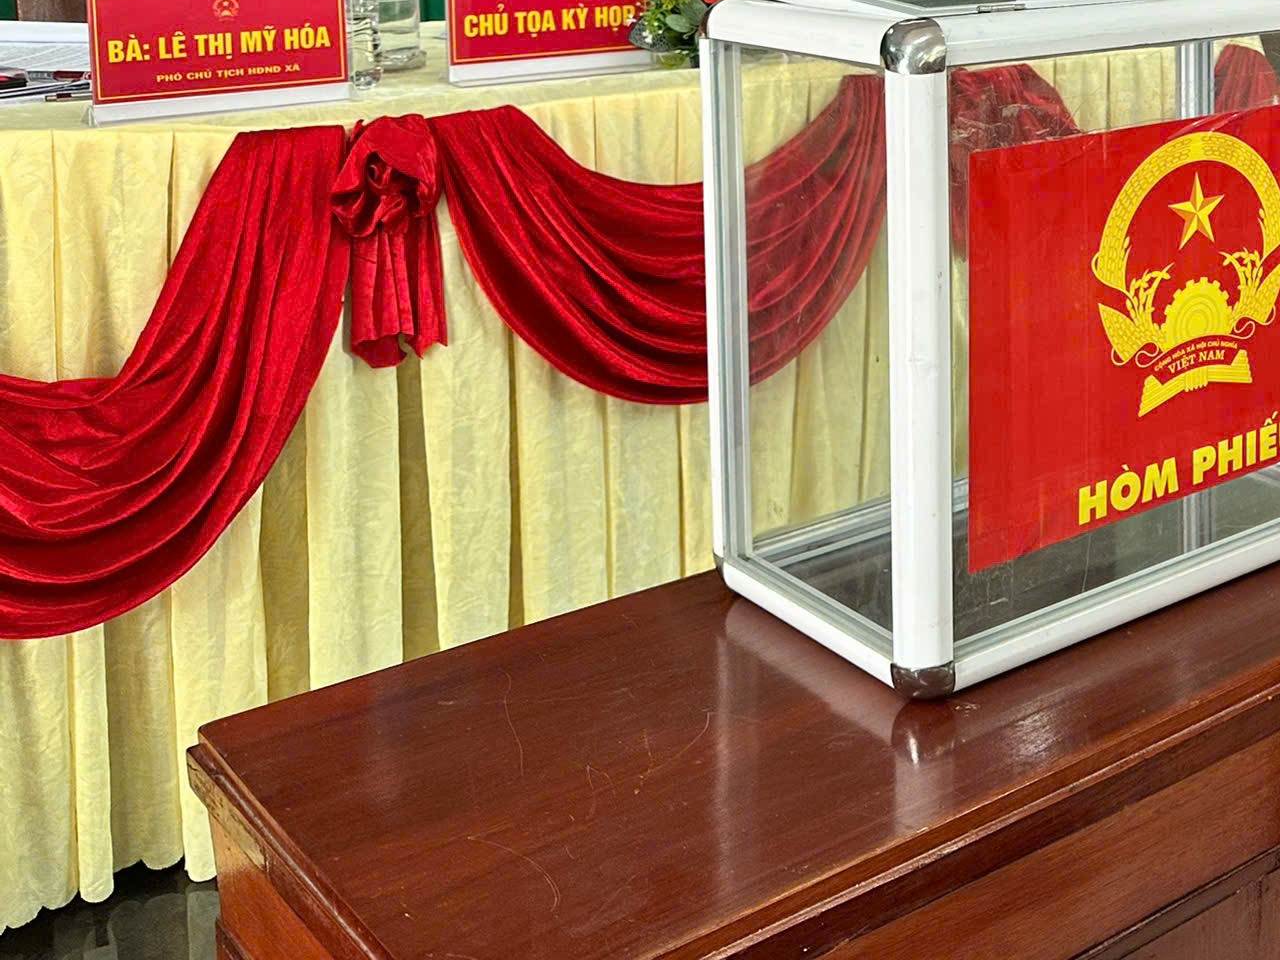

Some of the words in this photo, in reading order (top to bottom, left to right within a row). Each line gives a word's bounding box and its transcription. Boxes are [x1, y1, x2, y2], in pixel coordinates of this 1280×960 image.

[463, 3, 509, 38] CHỦ
[514, 12, 556, 38] TỌA
[564, 4, 587, 32] KỲ
[594, 3, 636, 32] HỌP
[107, 33, 151, 64] BÀ:
[157, 30, 188, 60] LÊ
[193, 32, 233, 60] THỊ
[240, 25, 278, 55] MỸ
[283, 22, 331, 51] HÓA
[156, 71, 184, 83] PHÓ
[186, 69, 213, 81] CHỦ
[215, 67, 245, 80] TỊCH
[1168, 353, 1196, 373] VIỆT
[1199, 349, 1225, 362] NAM
[1078, 456, 1179, 526] HÒM
